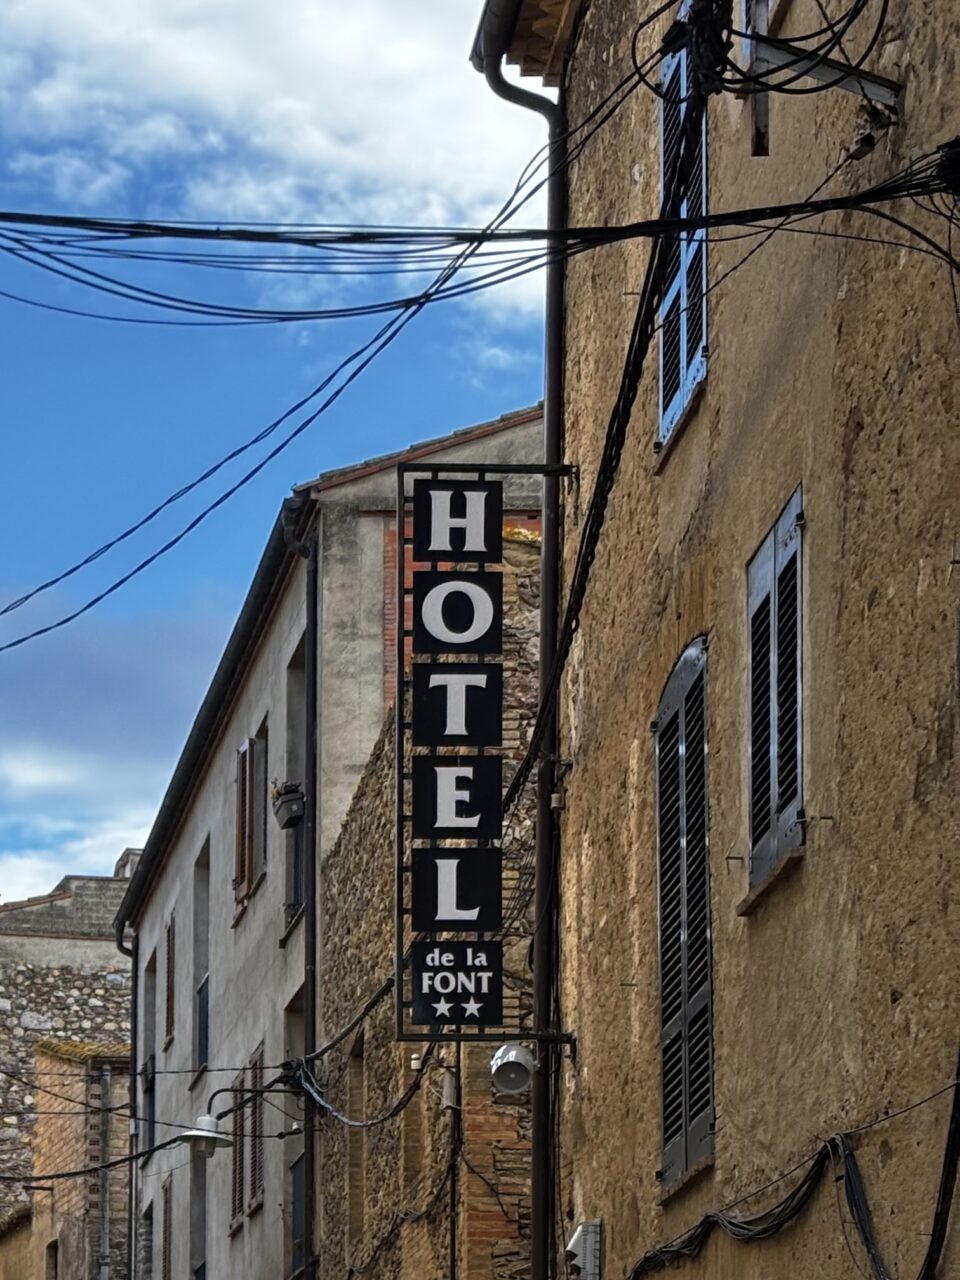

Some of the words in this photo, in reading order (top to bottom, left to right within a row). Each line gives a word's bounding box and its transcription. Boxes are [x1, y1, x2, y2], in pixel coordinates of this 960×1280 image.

[421, 490, 494, 921] HOTEL
[425, 947, 455, 967] de
[466, 947, 488, 967] la
[421, 971, 493, 994] FONT
